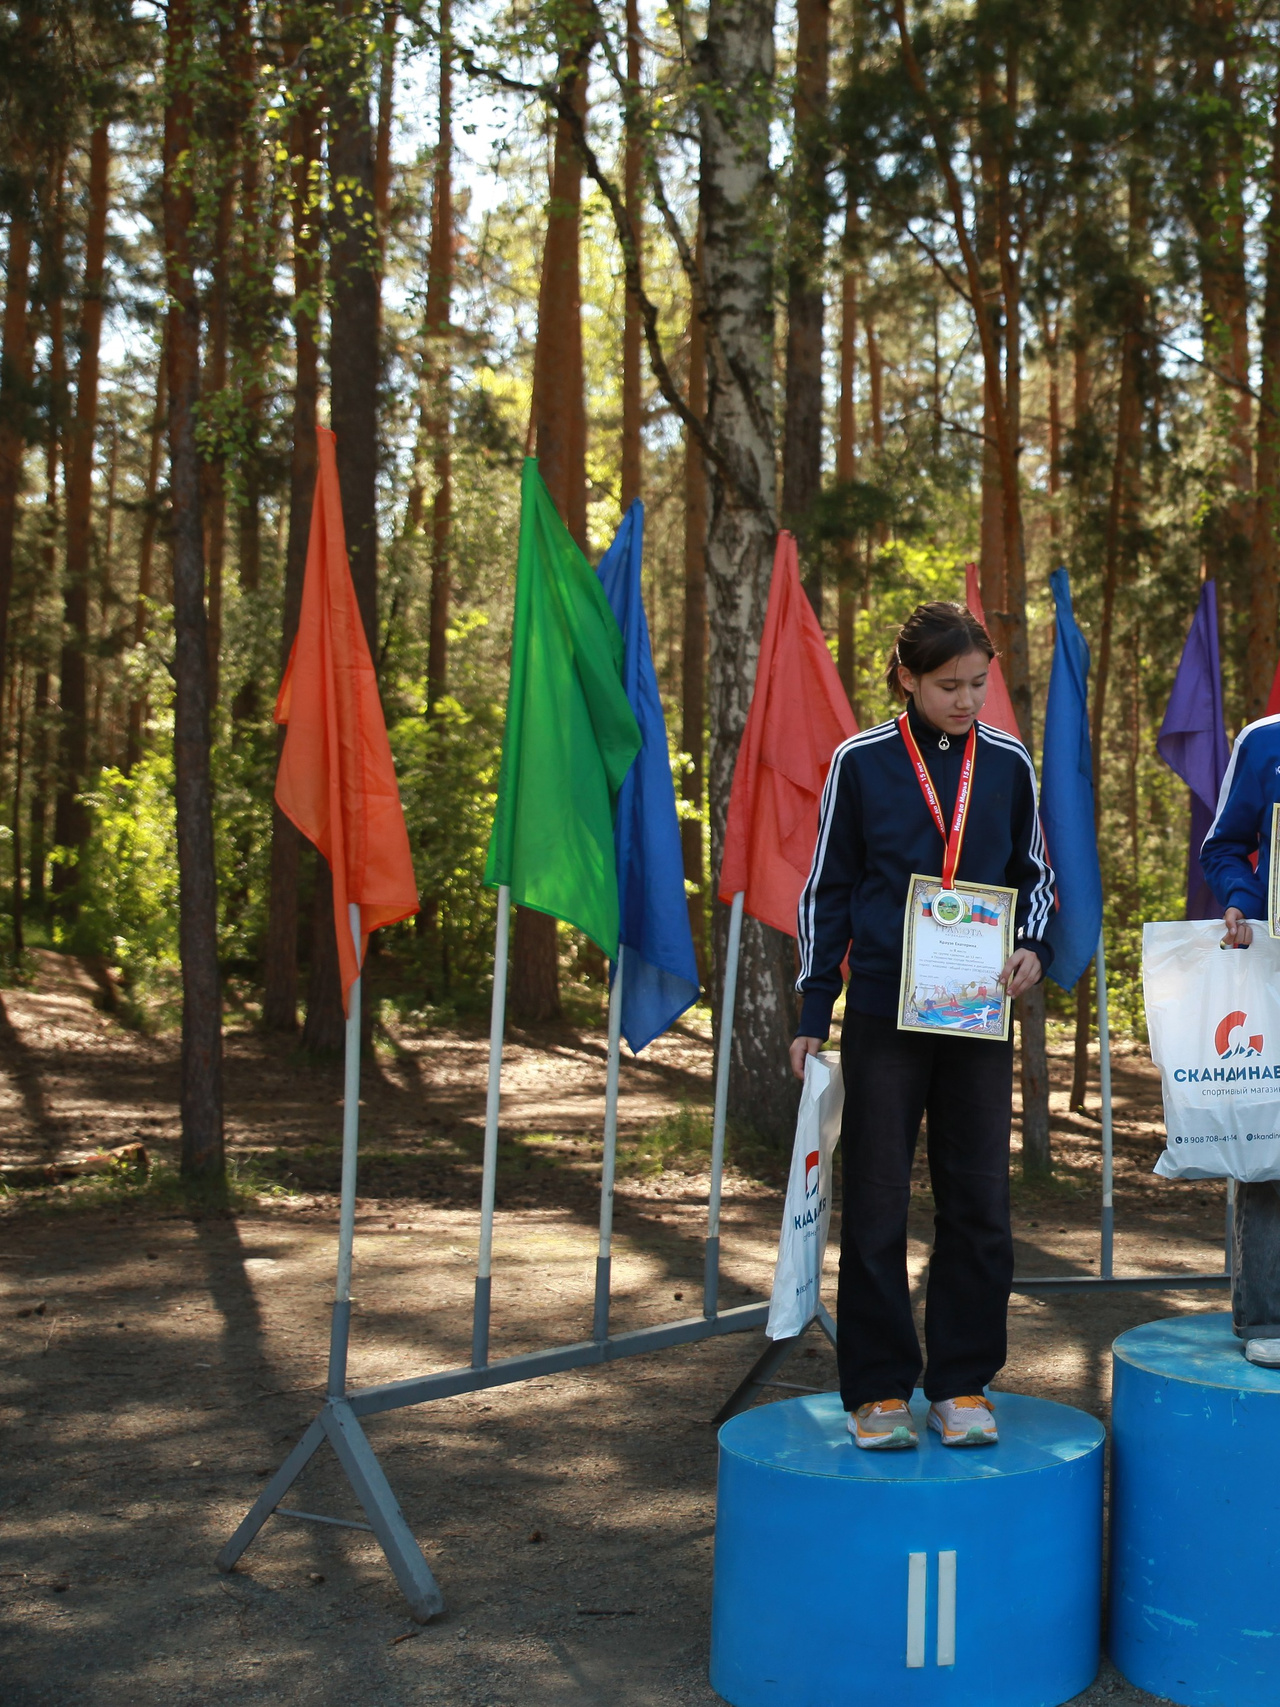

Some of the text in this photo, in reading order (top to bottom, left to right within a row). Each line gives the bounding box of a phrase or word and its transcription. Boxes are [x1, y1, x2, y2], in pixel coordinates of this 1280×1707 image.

[917, 761, 925, 772] лет
[919, 773, 927, 782] 15
[962, 770, 970, 779] 15
[924, 783, 936, 805] Марья
[959, 782, 969, 803] Марья
[958, 803, 965, 813] да
[953, 813, 963, 832] Иван
[1184, 1136, 1189, 1144] 8
[1190, 1136, 1205, 1144] 908
[906, 1550, 957, 1668] II
